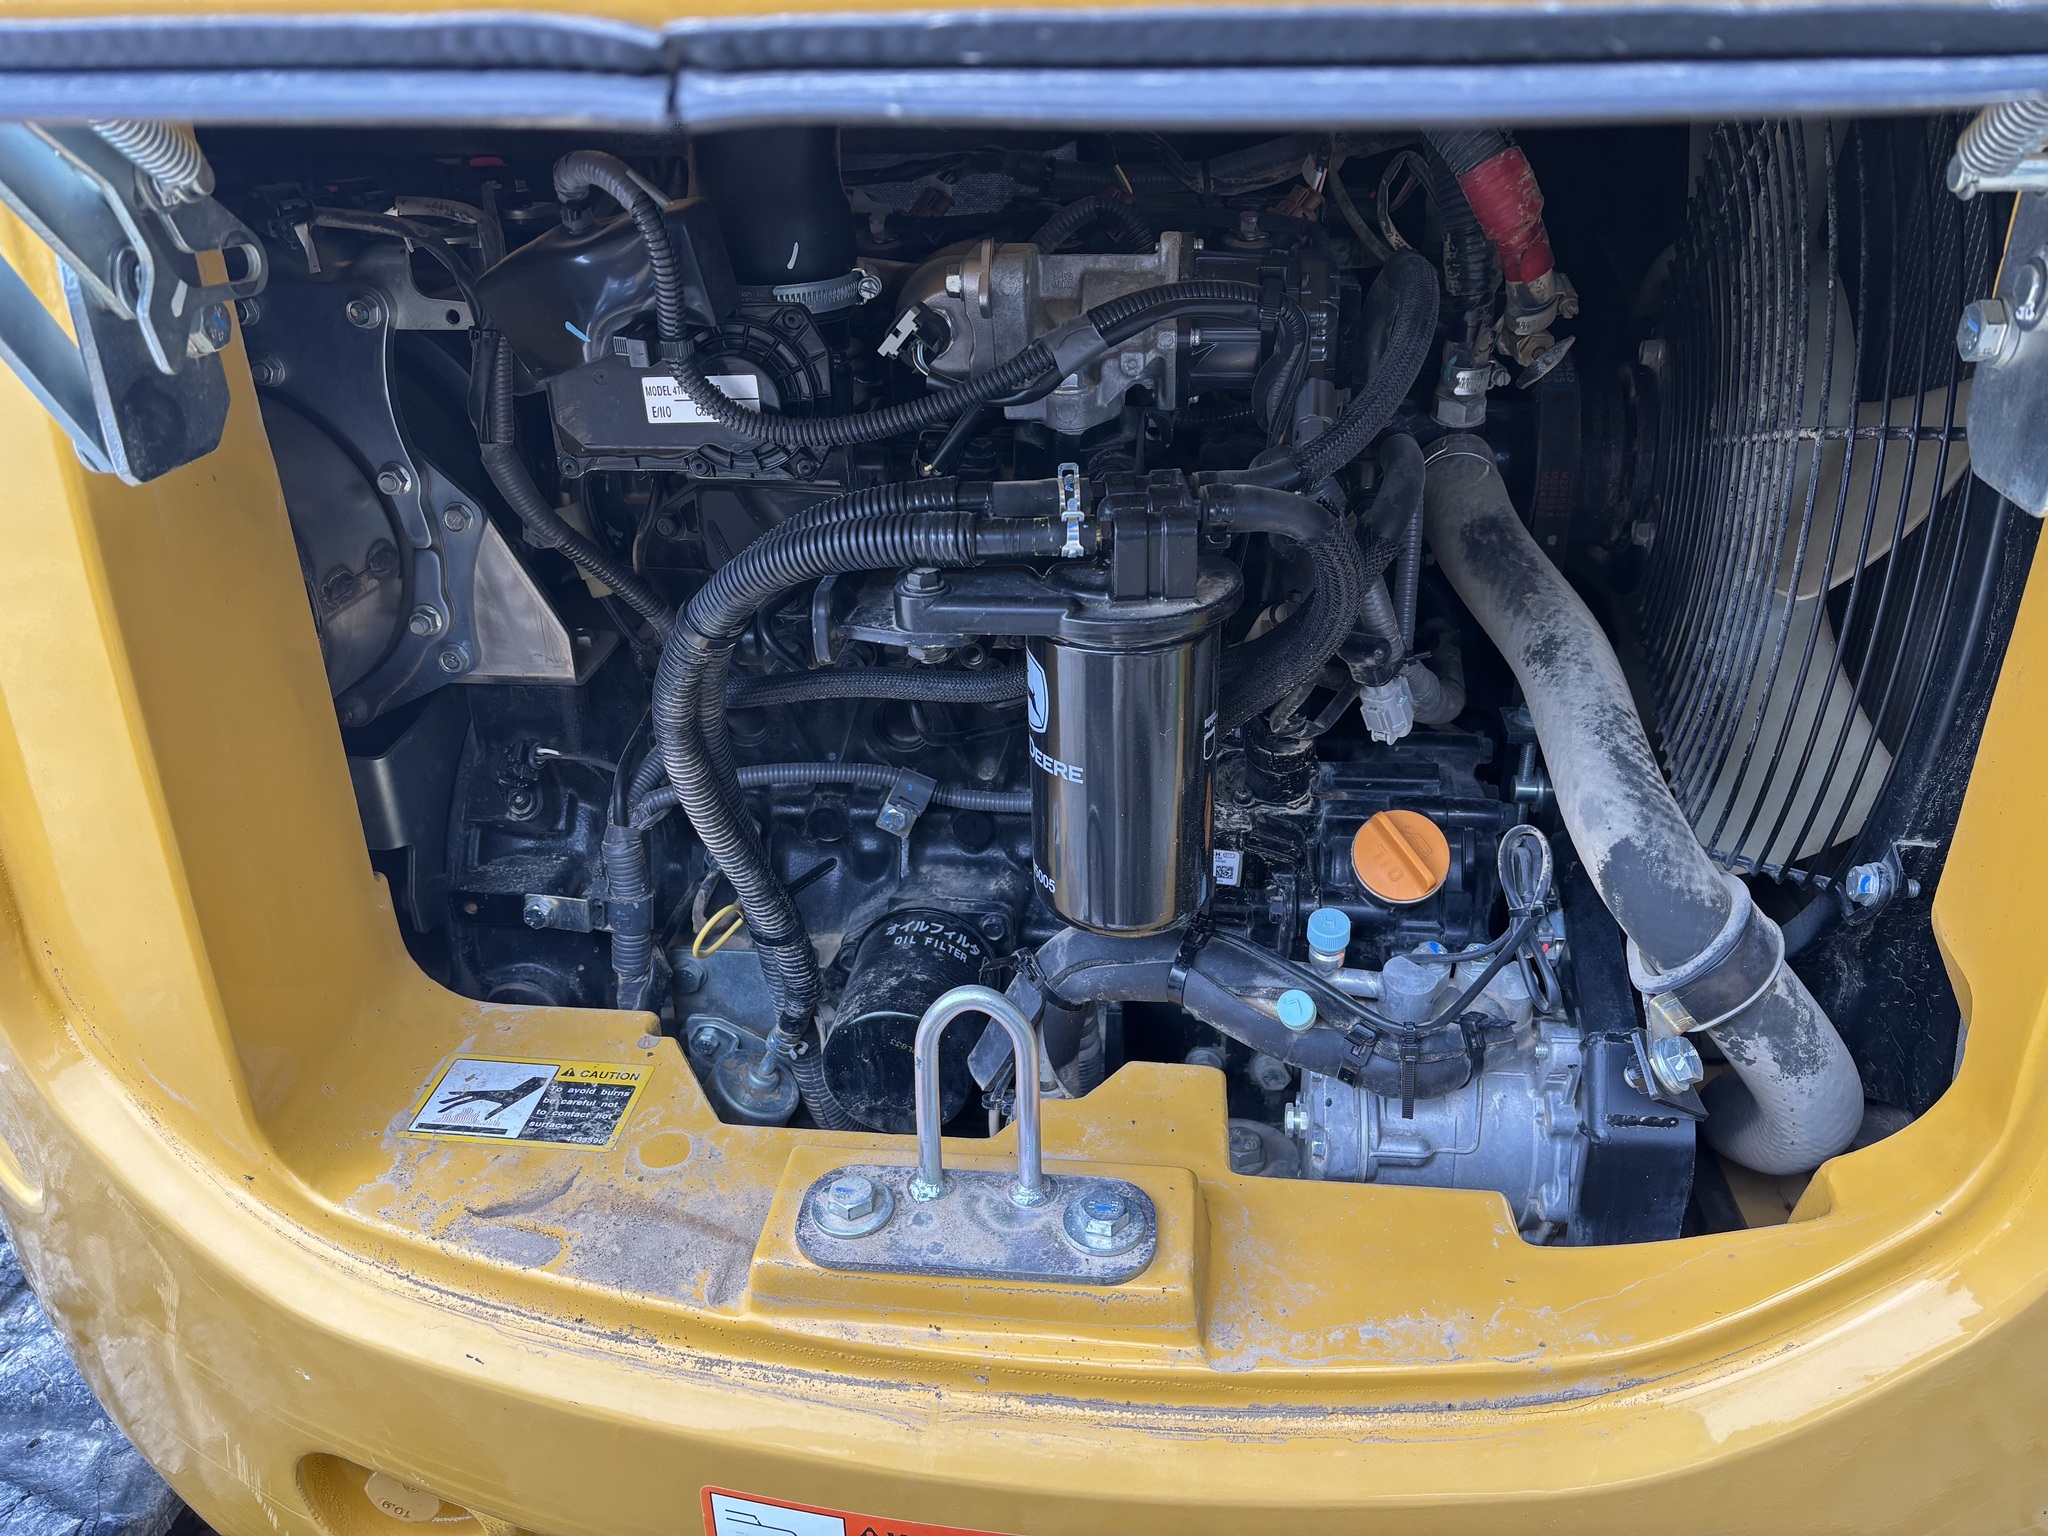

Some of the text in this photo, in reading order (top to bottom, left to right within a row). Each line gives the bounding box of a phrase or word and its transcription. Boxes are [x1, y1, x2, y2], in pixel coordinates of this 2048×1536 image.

[645, 385, 671, 396] MODEL
[1029, 734, 1084, 784] DEERE
[885, 920, 980, 955] オイルフィルタ
[894, 935, 967, 963] OIL FILTER
[580, 1069, 641, 1081] CAUTION
[550, 1085, 630, 1097] To avoid burns
[543, 1096, 619, 1108] be careful not
[536, 1108, 613, 1120] to contact hot
[529, 1120, 575, 1130] surfaces.
